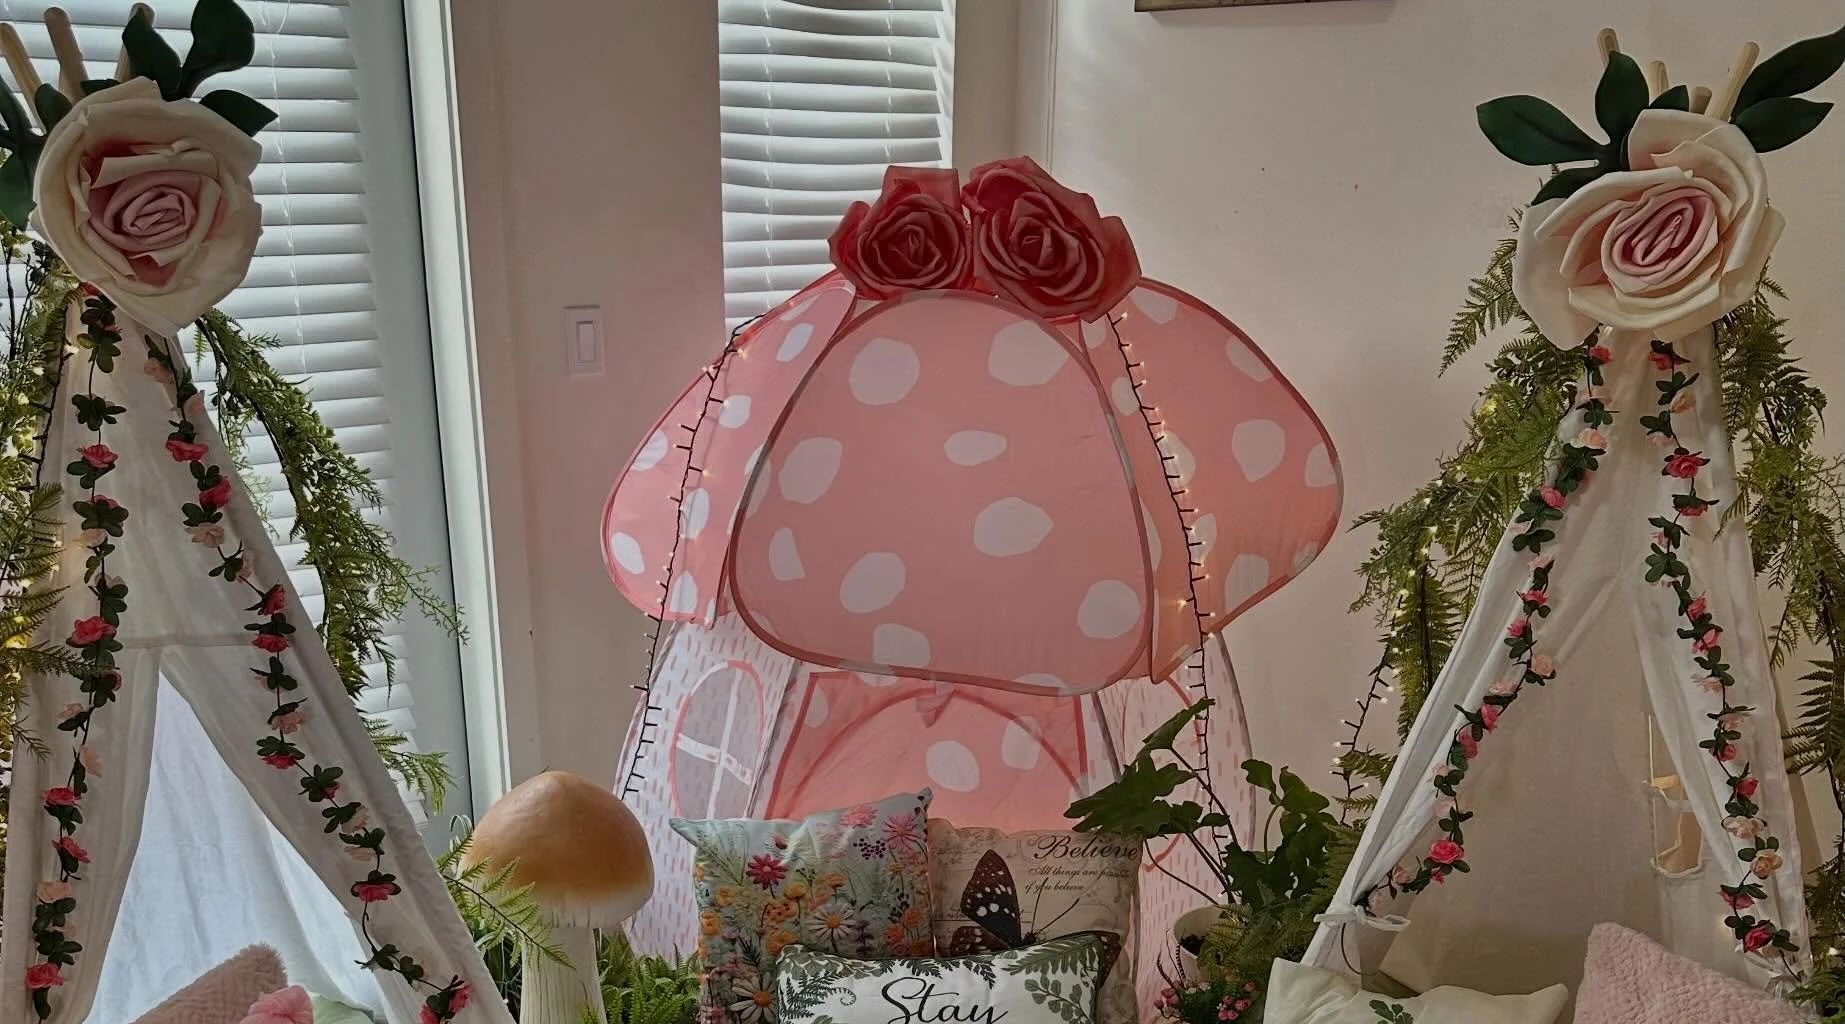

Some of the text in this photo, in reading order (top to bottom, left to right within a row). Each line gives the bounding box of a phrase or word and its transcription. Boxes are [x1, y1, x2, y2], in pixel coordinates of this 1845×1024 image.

[1034, 835, 1138, 860] Believe
[1029, 865, 1049, 876] All
[1052, 866, 1080, 881] things
[1025, 881, 1036, 894] if
